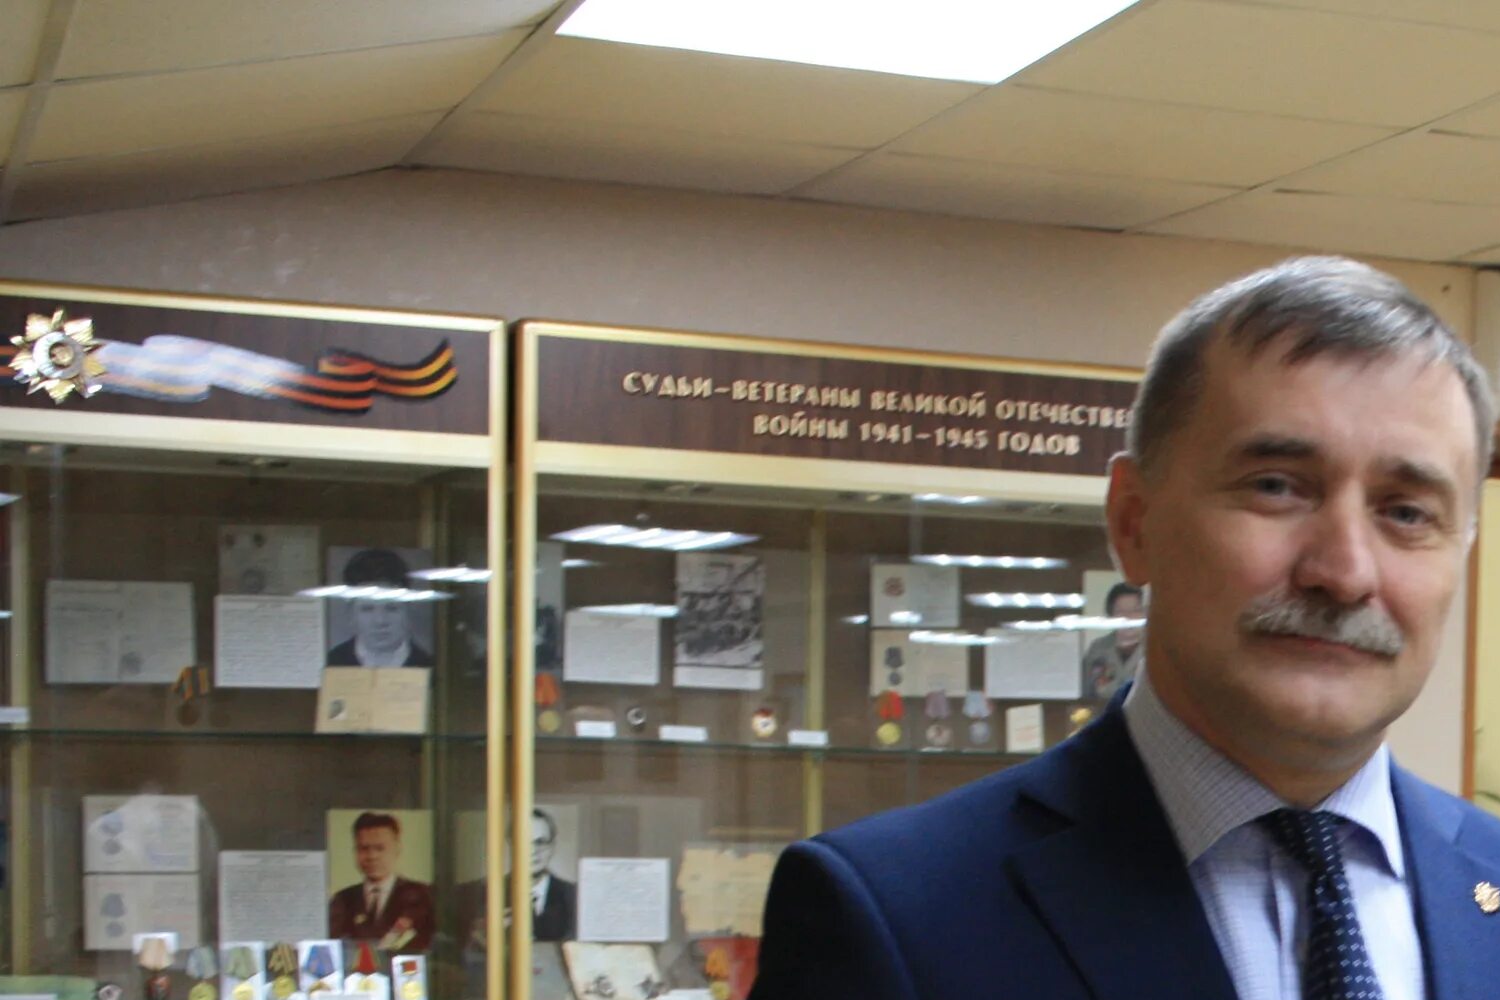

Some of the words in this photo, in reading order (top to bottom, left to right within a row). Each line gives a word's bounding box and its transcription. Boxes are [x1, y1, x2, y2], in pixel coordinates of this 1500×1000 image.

[622, 371, 861, 408] СУДЬИ-ВЕТЕРАНЫ
[870, 390, 986, 418] ВЕЛИКОЙ
[995, 399, 1134, 428] ОТЕЧЕСТВЕ
[753, 410, 849, 440] ВОЙНЫ
[997, 430, 1081, 456] ГОДОВ
